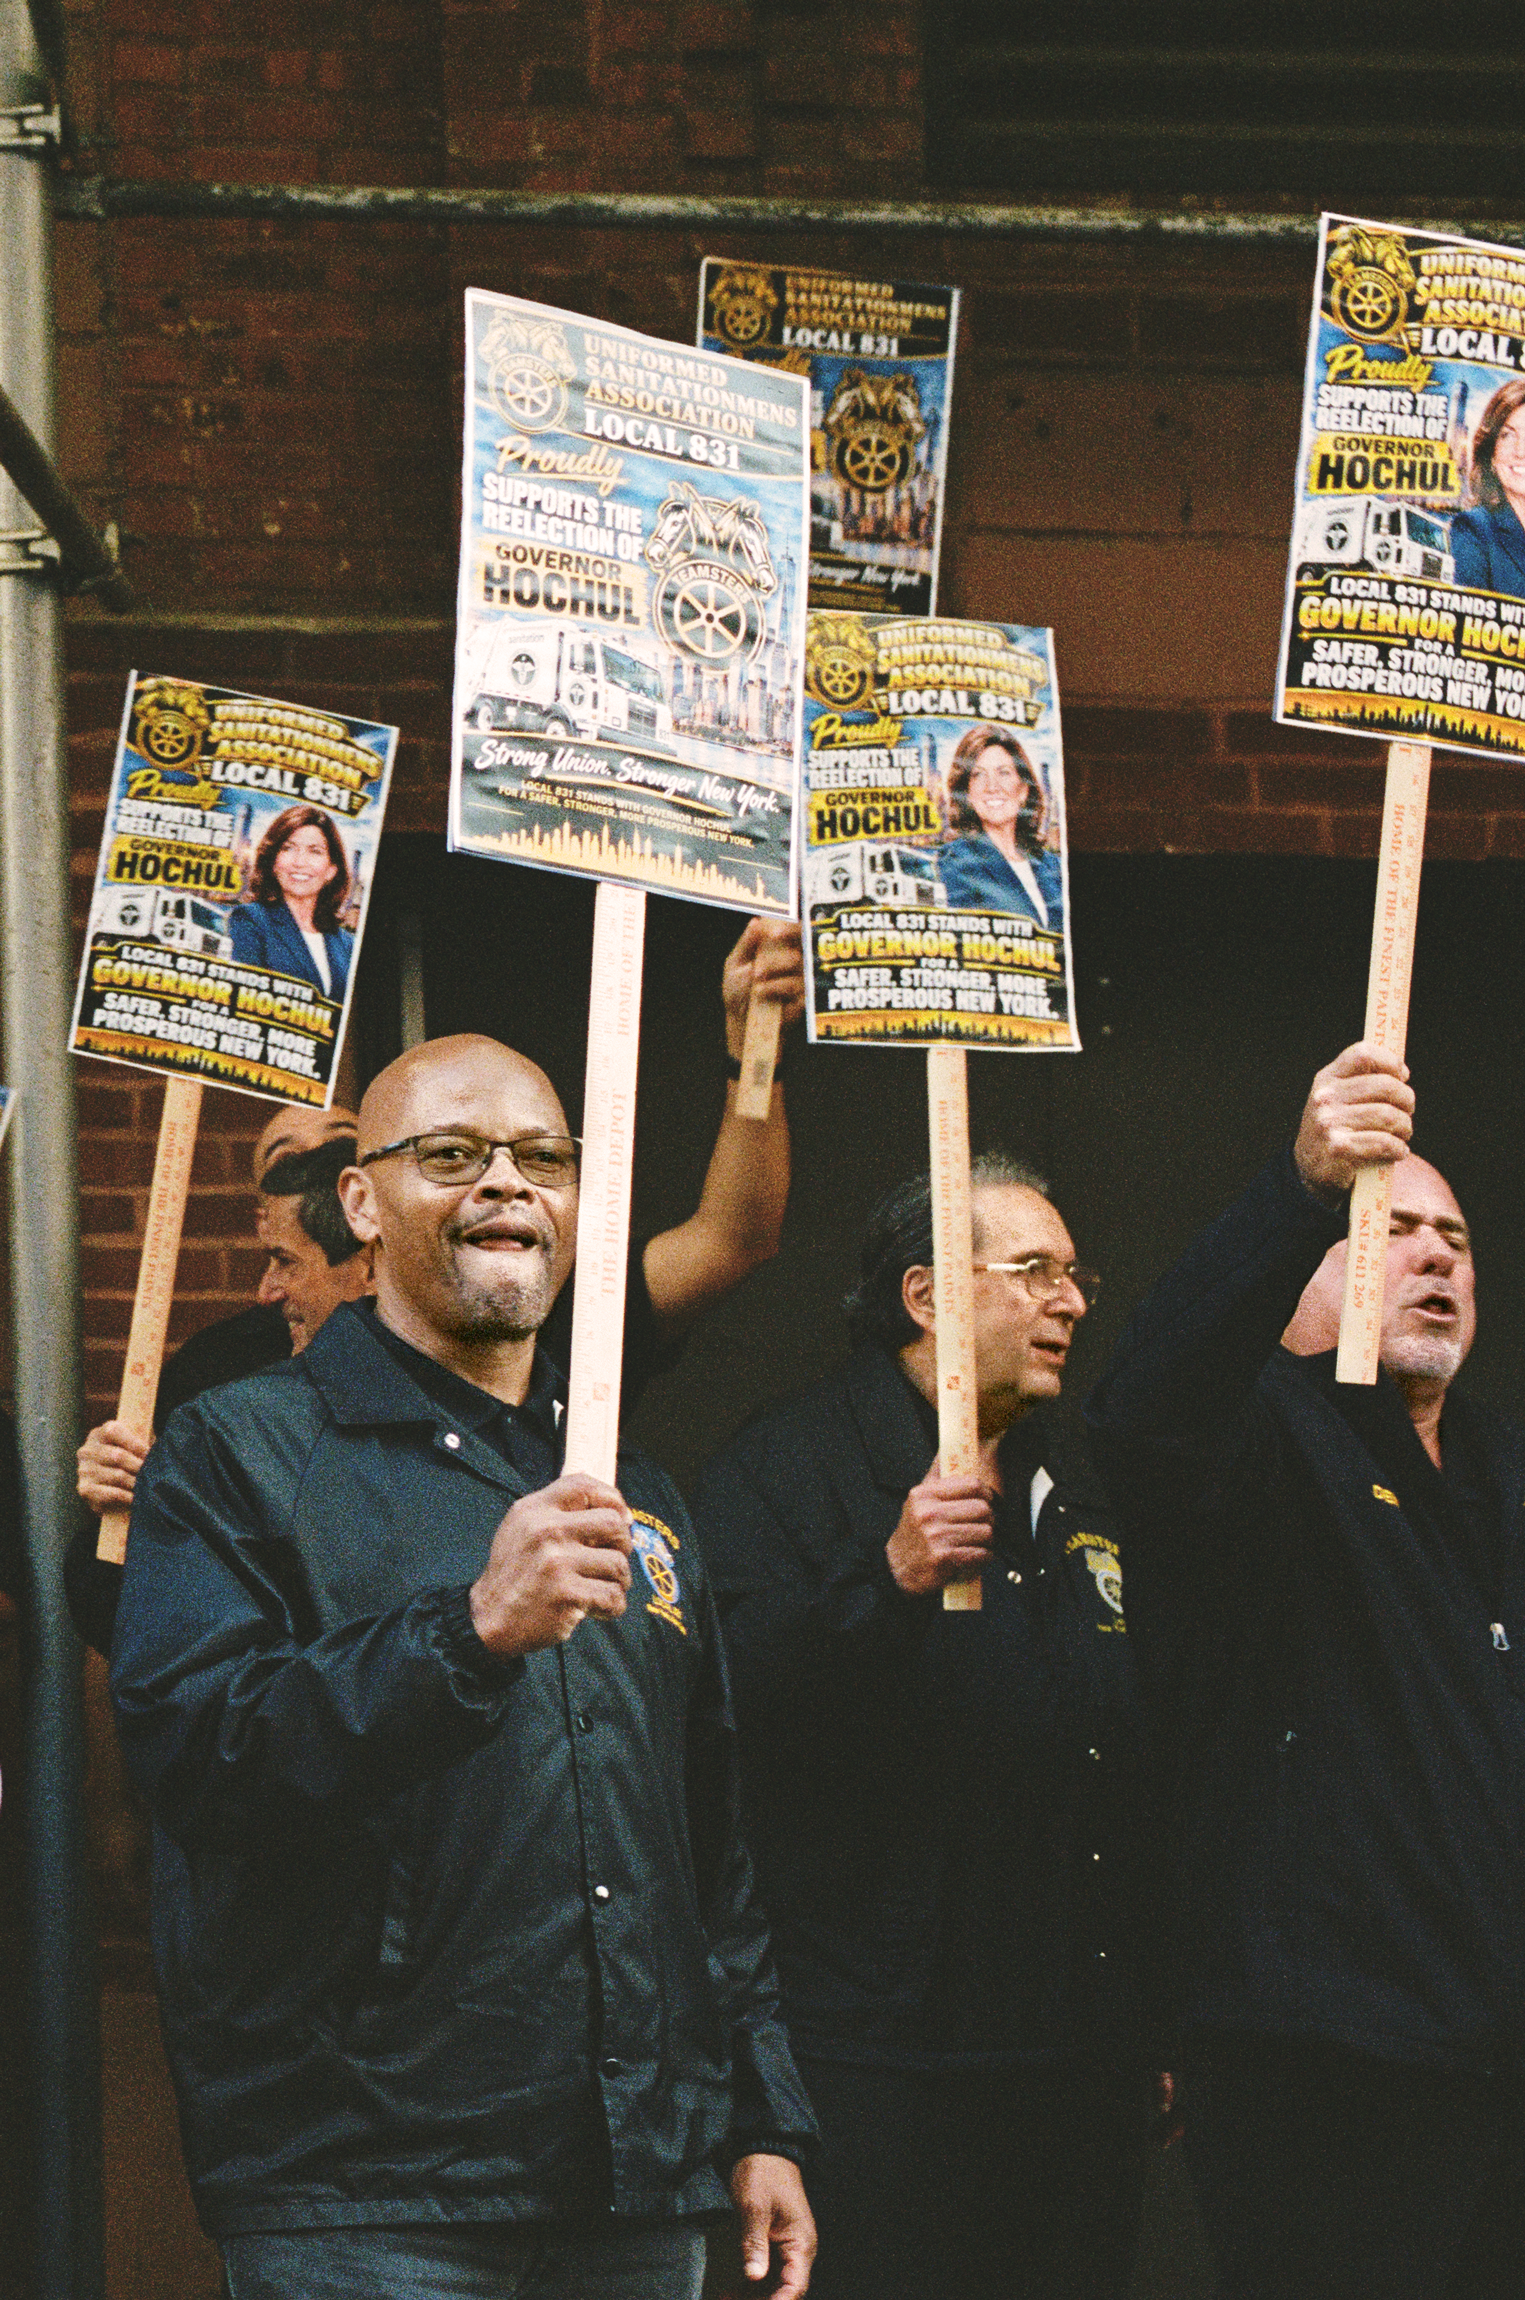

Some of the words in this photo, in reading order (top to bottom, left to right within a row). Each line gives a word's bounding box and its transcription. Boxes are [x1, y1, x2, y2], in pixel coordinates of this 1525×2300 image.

[1420, 254, 1525, 283] UNIFORM
[1415, 276, 1525, 308] SANITATIO
[1423, 301, 1525, 333] ASSOCIA
[783, 326, 855, 352] LOCAL
[1420, 327, 1515, 366] LOCAL
[584, 334, 728, 387] UNIFORMED
[1325, 343, 1433, 392] Proudly
[584, 356, 798, 428] SANITATIONMENS
[585, 380, 755, 439] ASSOCIATION
[1318, 384, 1412, 414] SUPPORTS
[1415, 393, 1448, 417] THE
[584, 407, 683, 456] LOCAL
[688, 434, 741, 470] 831
[1315, 406, 1423, 437] REELECTION
[1425, 417, 1448, 440] OF
[495, 435, 626, 496] Proudly
[1333, 436, 1435, 459] GOVERNOR
[1317, 453, 1456, 492] HOCHUL
[482, 472, 600, 525] SUPPORTS
[602, 500, 642, 534] THE
[482, 500, 615, 559] REELECTION
[617, 535, 644, 562] OF
[495, 542, 622, 582] GOVERNOR
[484, 562, 642, 626] HOCHUL
[671, 564, 751, 605] TEAMSTERS
[1330, 577, 1391, 600] LOCAL
[1394, 584, 1428, 606] 831
[1429, 590, 1497, 619] STANDS
[877, 625, 1004, 649] UNIFORMED
[1299, 596, 1458, 643] GOVERNOR
[1414, 638, 1444, 655] FOR
[1445, 644, 1456, 657] A
[888, 663, 1031, 697] ASSOCIATION
[1301, 662, 1444, 702] PROSPEROUS
[1446, 679, 1493, 712] NEW
[1495, 666, 1525, 693] MO
[888, 689, 976, 717] LOCAL
[978, 695, 1026, 724] 831
[809, 714, 902, 749] Proudly
[475, 739, 549, 777] Strong
[553, 747, 612, 777] Union.
[616, 757, 696, 799] Stronger
[699, 776, 736, 803] New
[737, 785, 781, 817] York.
[808, 749, 891, 770] SUPPORTS
[892, 747, 919, 766] THE
[210, 760, 300, 795] LOCAL
[302, 779, 350, 811] 831
[808, 768, 903, 790] REELECTION
[498, 785, 517, 799] FOR
[519, 790, 528, 801] A
[619, 810, 647, 826] MORE
[648, 815, 706, 839] PROSPEROUS
[707, 828, 727, 843] NEW
[521, 779, 551, 796] LOCAL
[554, 785, 574, 798] 831
[575, 789, 615, 809] STANDS
[617, 798, 641, 814] WITH
[642, 803, 693, 825] GOVERNOR
[694, 814, 732, 833] HOCHUL
[825, 790, 915, 808] GOVERNOR
[815, 804, 938, 842] HOCHUL
[1391, 803, 1406, 855] HOME
[115, 851, 237, 890] HOCHUL
[1388, 859, 1400, 881] OF
[1385, 890, 1398, 921] THE
[622, 909, 636, 942] THE
[840, 913, 894, 930] LOCAL
[896, 913, 926, 930] 831
[927, 914, 991, 934] STANDS
[992, 918, 1033, 938] WITH
[621, 948, 634, 973] OF
[817, 931, 958, 961] GOVERNOR
[961, 934, 1062, 973] HOCHUL
[1379, 926, 1396, 990] FINEST
[121, 946, 174, 969] LOCAL
[272, 978, 314, 1002] WITH
[996, 974, 1047, 997] MORE
[92, 958, 233, 1006] GOVERNOR
[237, 986, 334, 1039] HOCHUL
[617, 977, 633, 1036] HOME
[828, 988, 953, 1011] PROSPEROUS
[955, 990, 997, 1013] NEW
[998, 996, 1059, 1020] YORK.
[92, 1008, 219, 1051] PROSPEROUS
[219, 1034, 265, 1062] NEW
[266, 1047, 322, 1080] YORK.
[267, 1028, 318, 1058] MORE
[608, 1089, 627, 1167] DEPOT
[604, 1170, 624, 1244] HOME
[602, 1252, 618, 1295] THE
[1355, 1255, 1367, 1279] 611
[1353, 1283, 1365, 1309] 269
